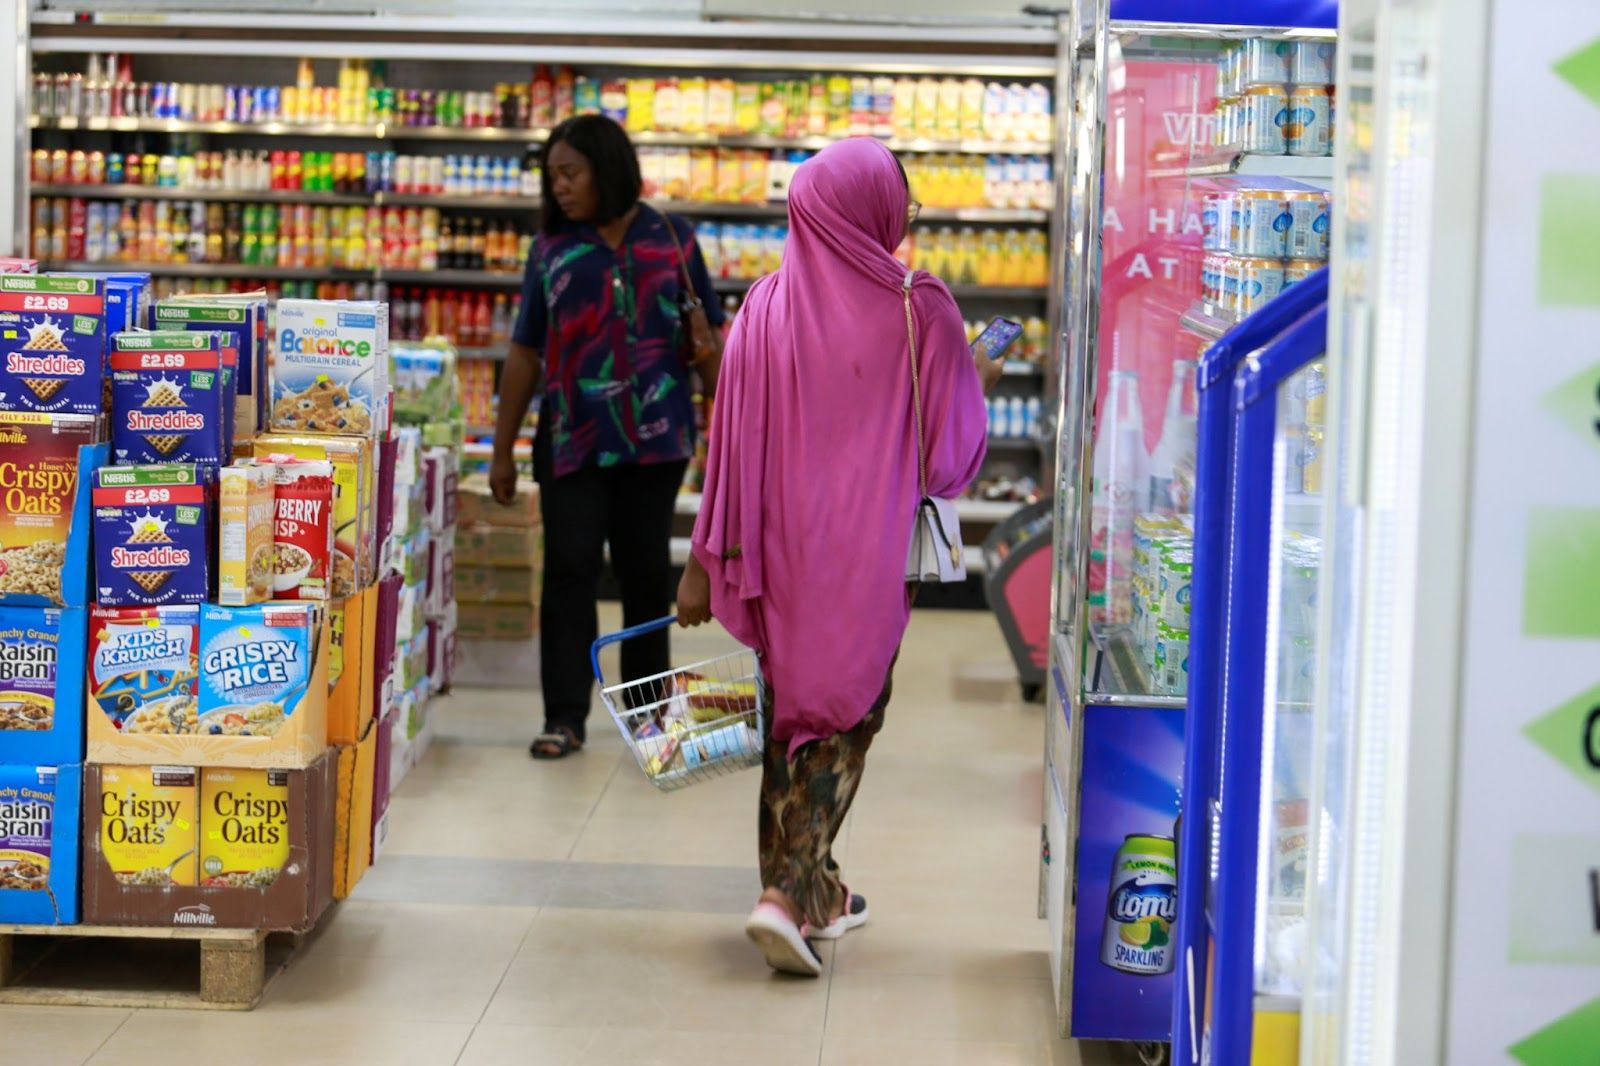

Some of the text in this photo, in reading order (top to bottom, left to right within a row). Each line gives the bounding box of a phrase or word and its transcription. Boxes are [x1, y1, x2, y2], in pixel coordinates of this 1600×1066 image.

[24, 296, 69, 311] £2.69
[303, 327, 337, 337] original
[281, 328, 371, 357] Balance
[7, 353, 84, 375] Shreddies
[141, 354, 185, 367] £2.69
[285, 354, 361, 367] MULTIGRAIN CEREAL
[20, 395, 69, 411] THE ORIGINAL
[128, 410, 204, 431] Shreddies
[40, 462, 78, 472] Honey Nu
[142, 451, 155, 463] THE
[0, 462, 77, 496] Crispy
[104, 474, 136, 484] Nestlé
[5, 488, 62, 514] Oats
[274, 498, 322, 526] BERRY
[112, 546, 190, 568] Shreddies
[126, 588, 177, 604] THE ORIGINAL
[92, 609, 119, 618] Millville
[205, 612, 233, 620] Millville
[0, 642, 57, 662] Raisin
[102, 638, 184, 667] KRUNCH
[204, 640, 297, 674] CRISPY
[0, 662, 48, 680] Bran
[223, 662, 288, 691] RICE
[0, 801, 50, 820] aisin
[101, 791, 181, 824] Crispy
[214, 791, 288, 825] Crispy
[108, 818, 166, 844] Oats
[222, 818, 280, 844] Oats
[173, 911, 215, 924] Millville
[1114, 944, 1165, 967] SPARKLING
